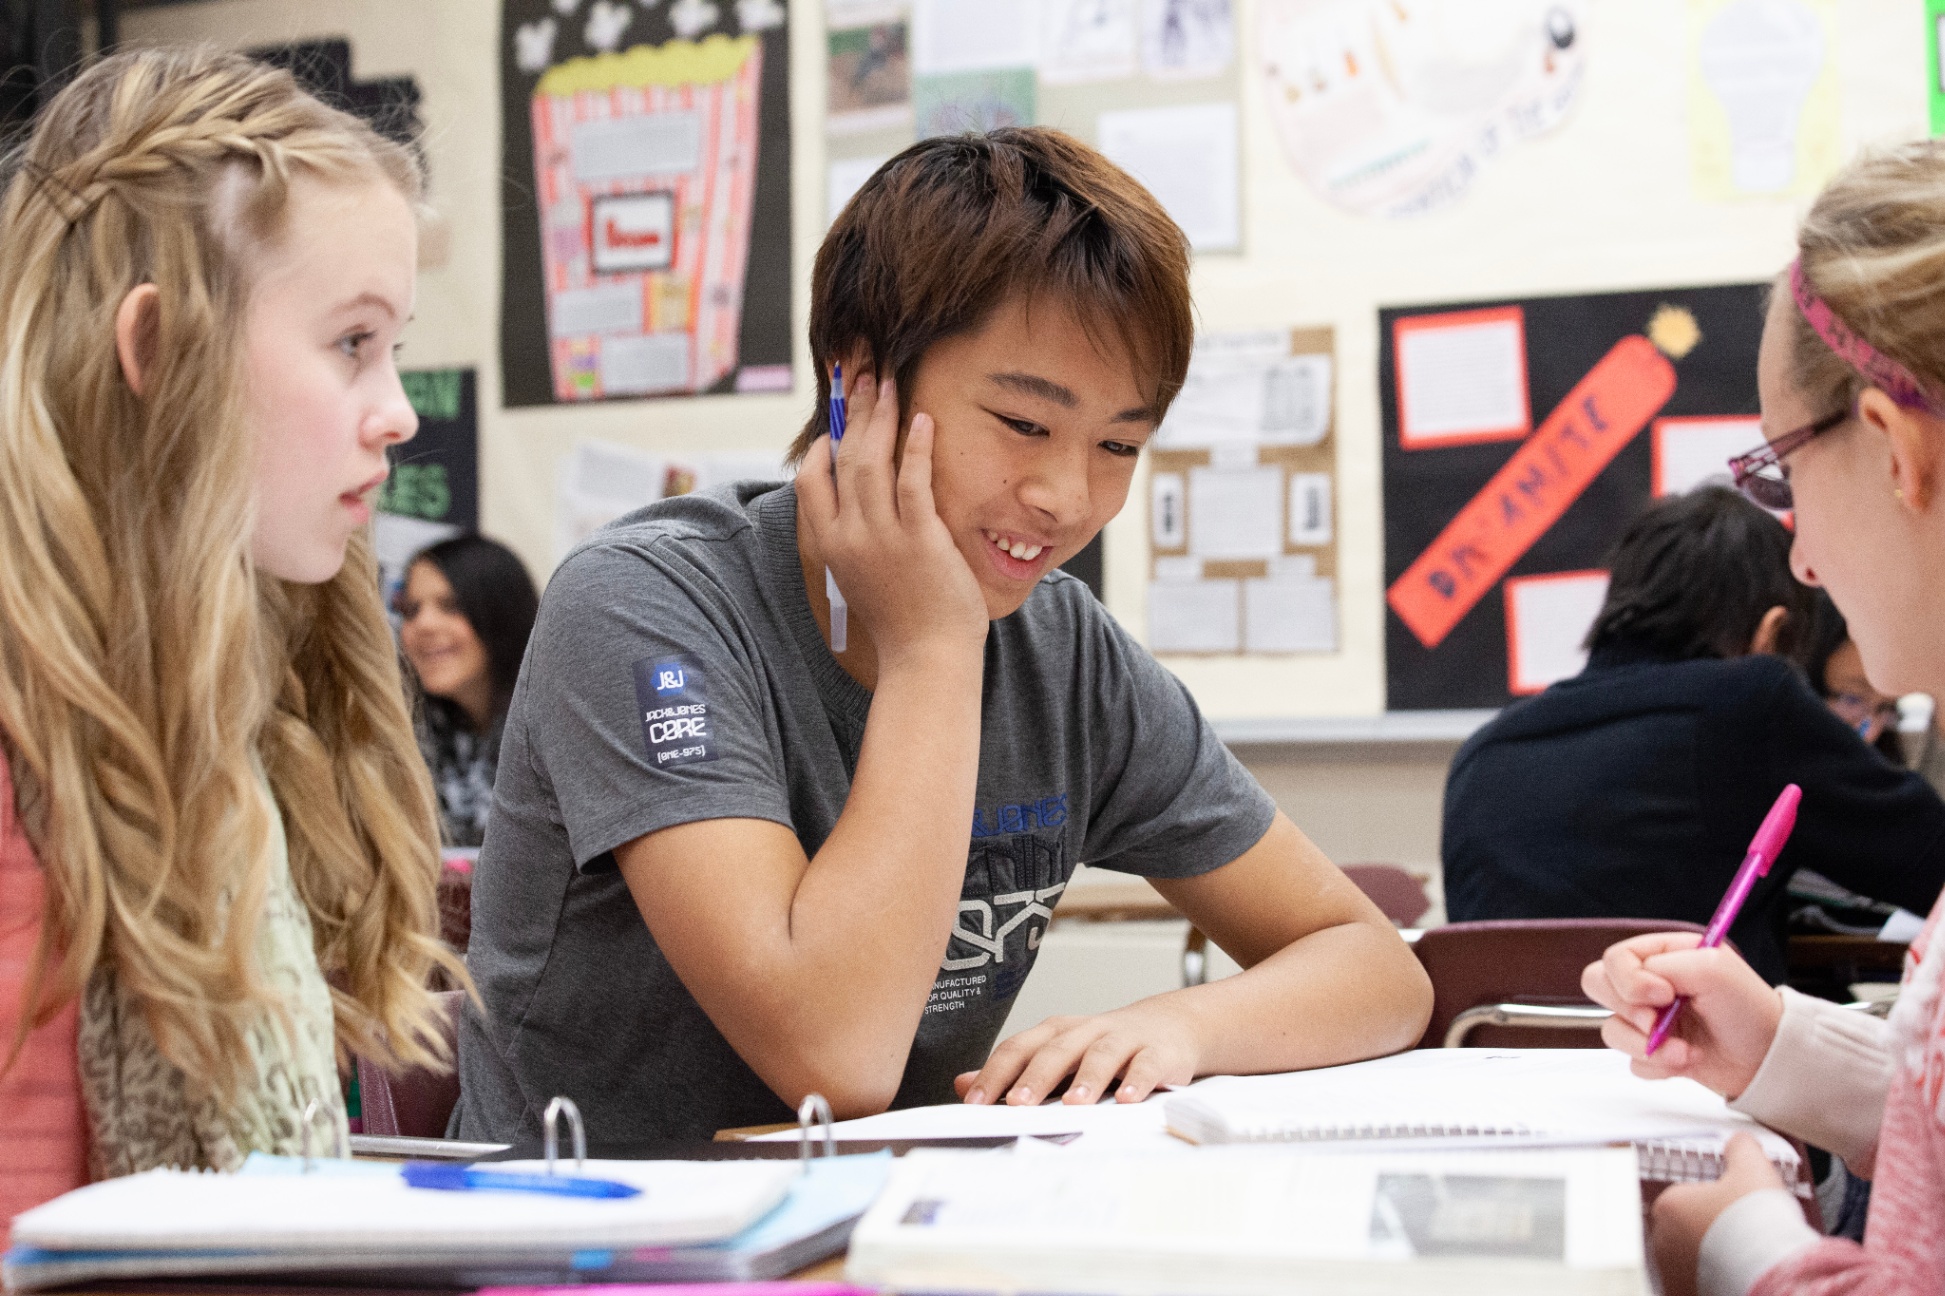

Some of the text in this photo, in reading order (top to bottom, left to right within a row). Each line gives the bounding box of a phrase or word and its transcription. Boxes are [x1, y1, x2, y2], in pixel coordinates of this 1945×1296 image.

[656, 669, 684, 691] J&J
[645, 703, 706, 722] JACK&JONES
[930, 974, 987, 991] NUFACTURED
[927, 993, 939, 1003] OR
[939, 988, 976, 1000] QUALITY
[924, 1000, 966, 1015] STRENGTH
